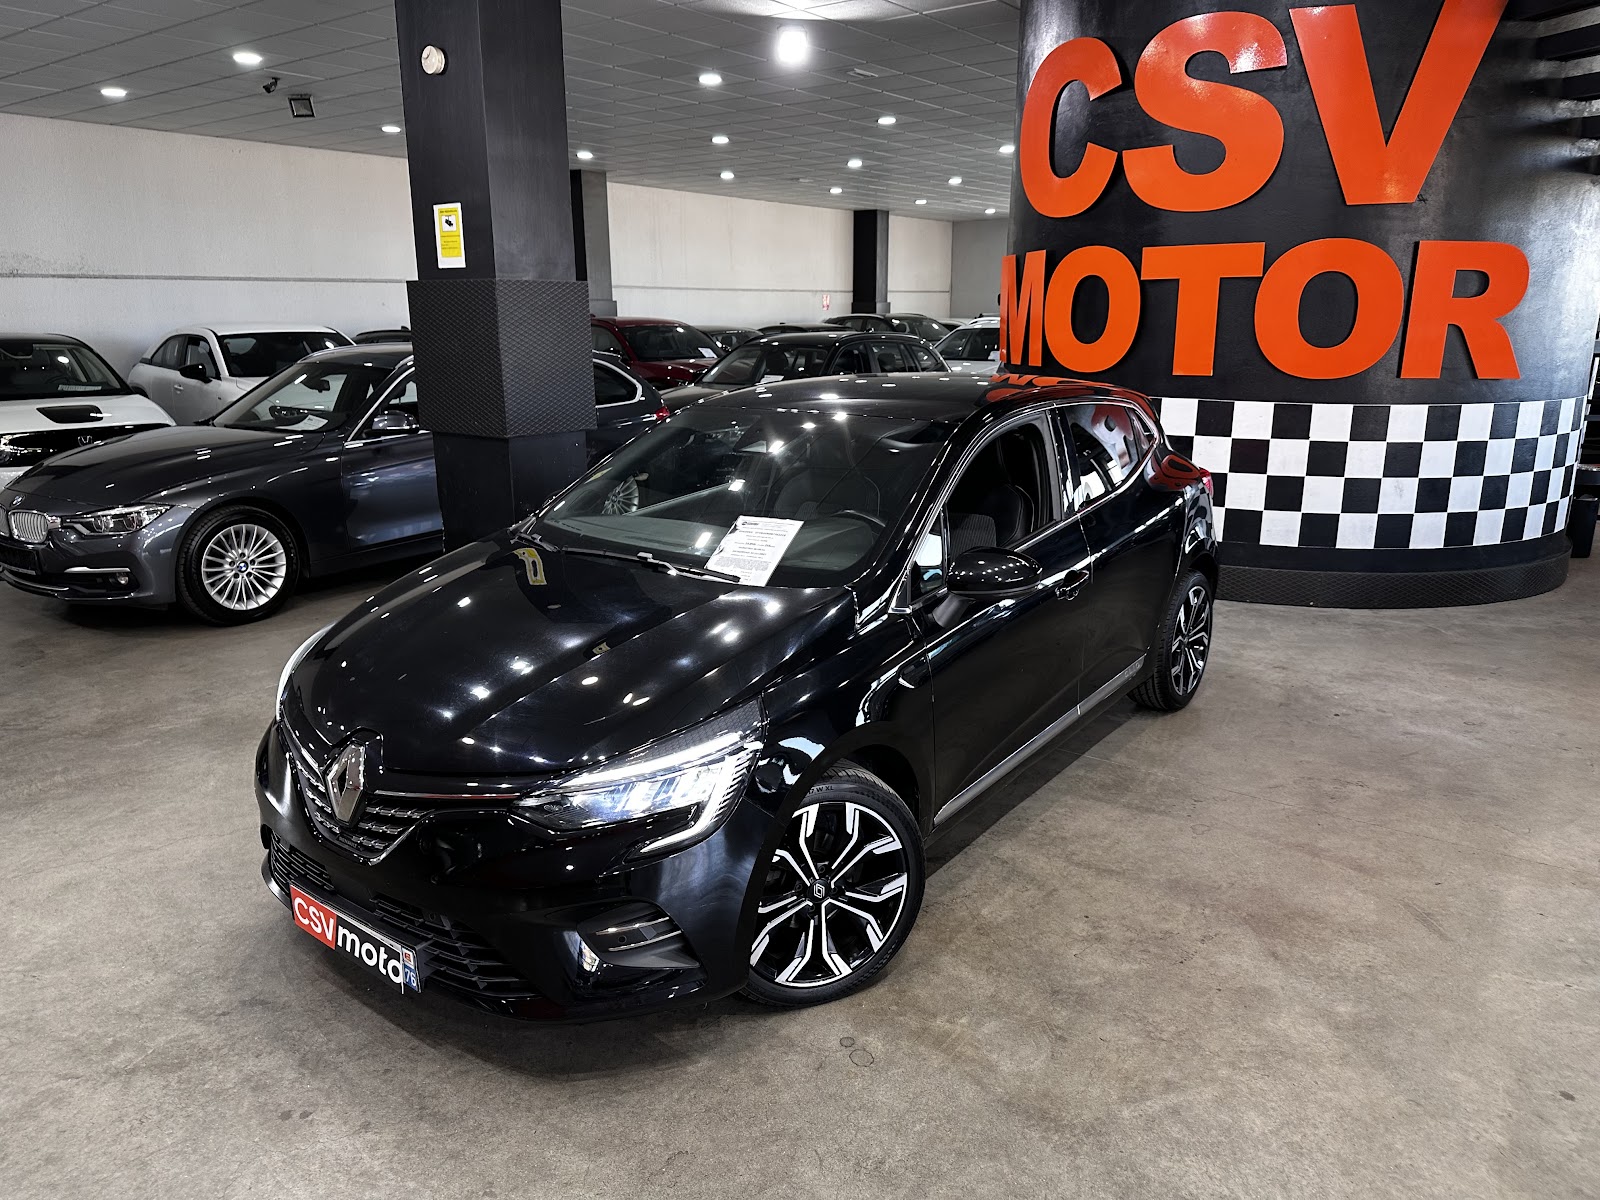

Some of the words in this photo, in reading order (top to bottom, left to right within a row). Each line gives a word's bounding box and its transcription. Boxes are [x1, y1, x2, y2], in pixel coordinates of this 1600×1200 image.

[1020, 0, 1506, 217] CSV
[1000, 238, 1529, 379] MOTOR
[404, 968, 417, 987] 76
